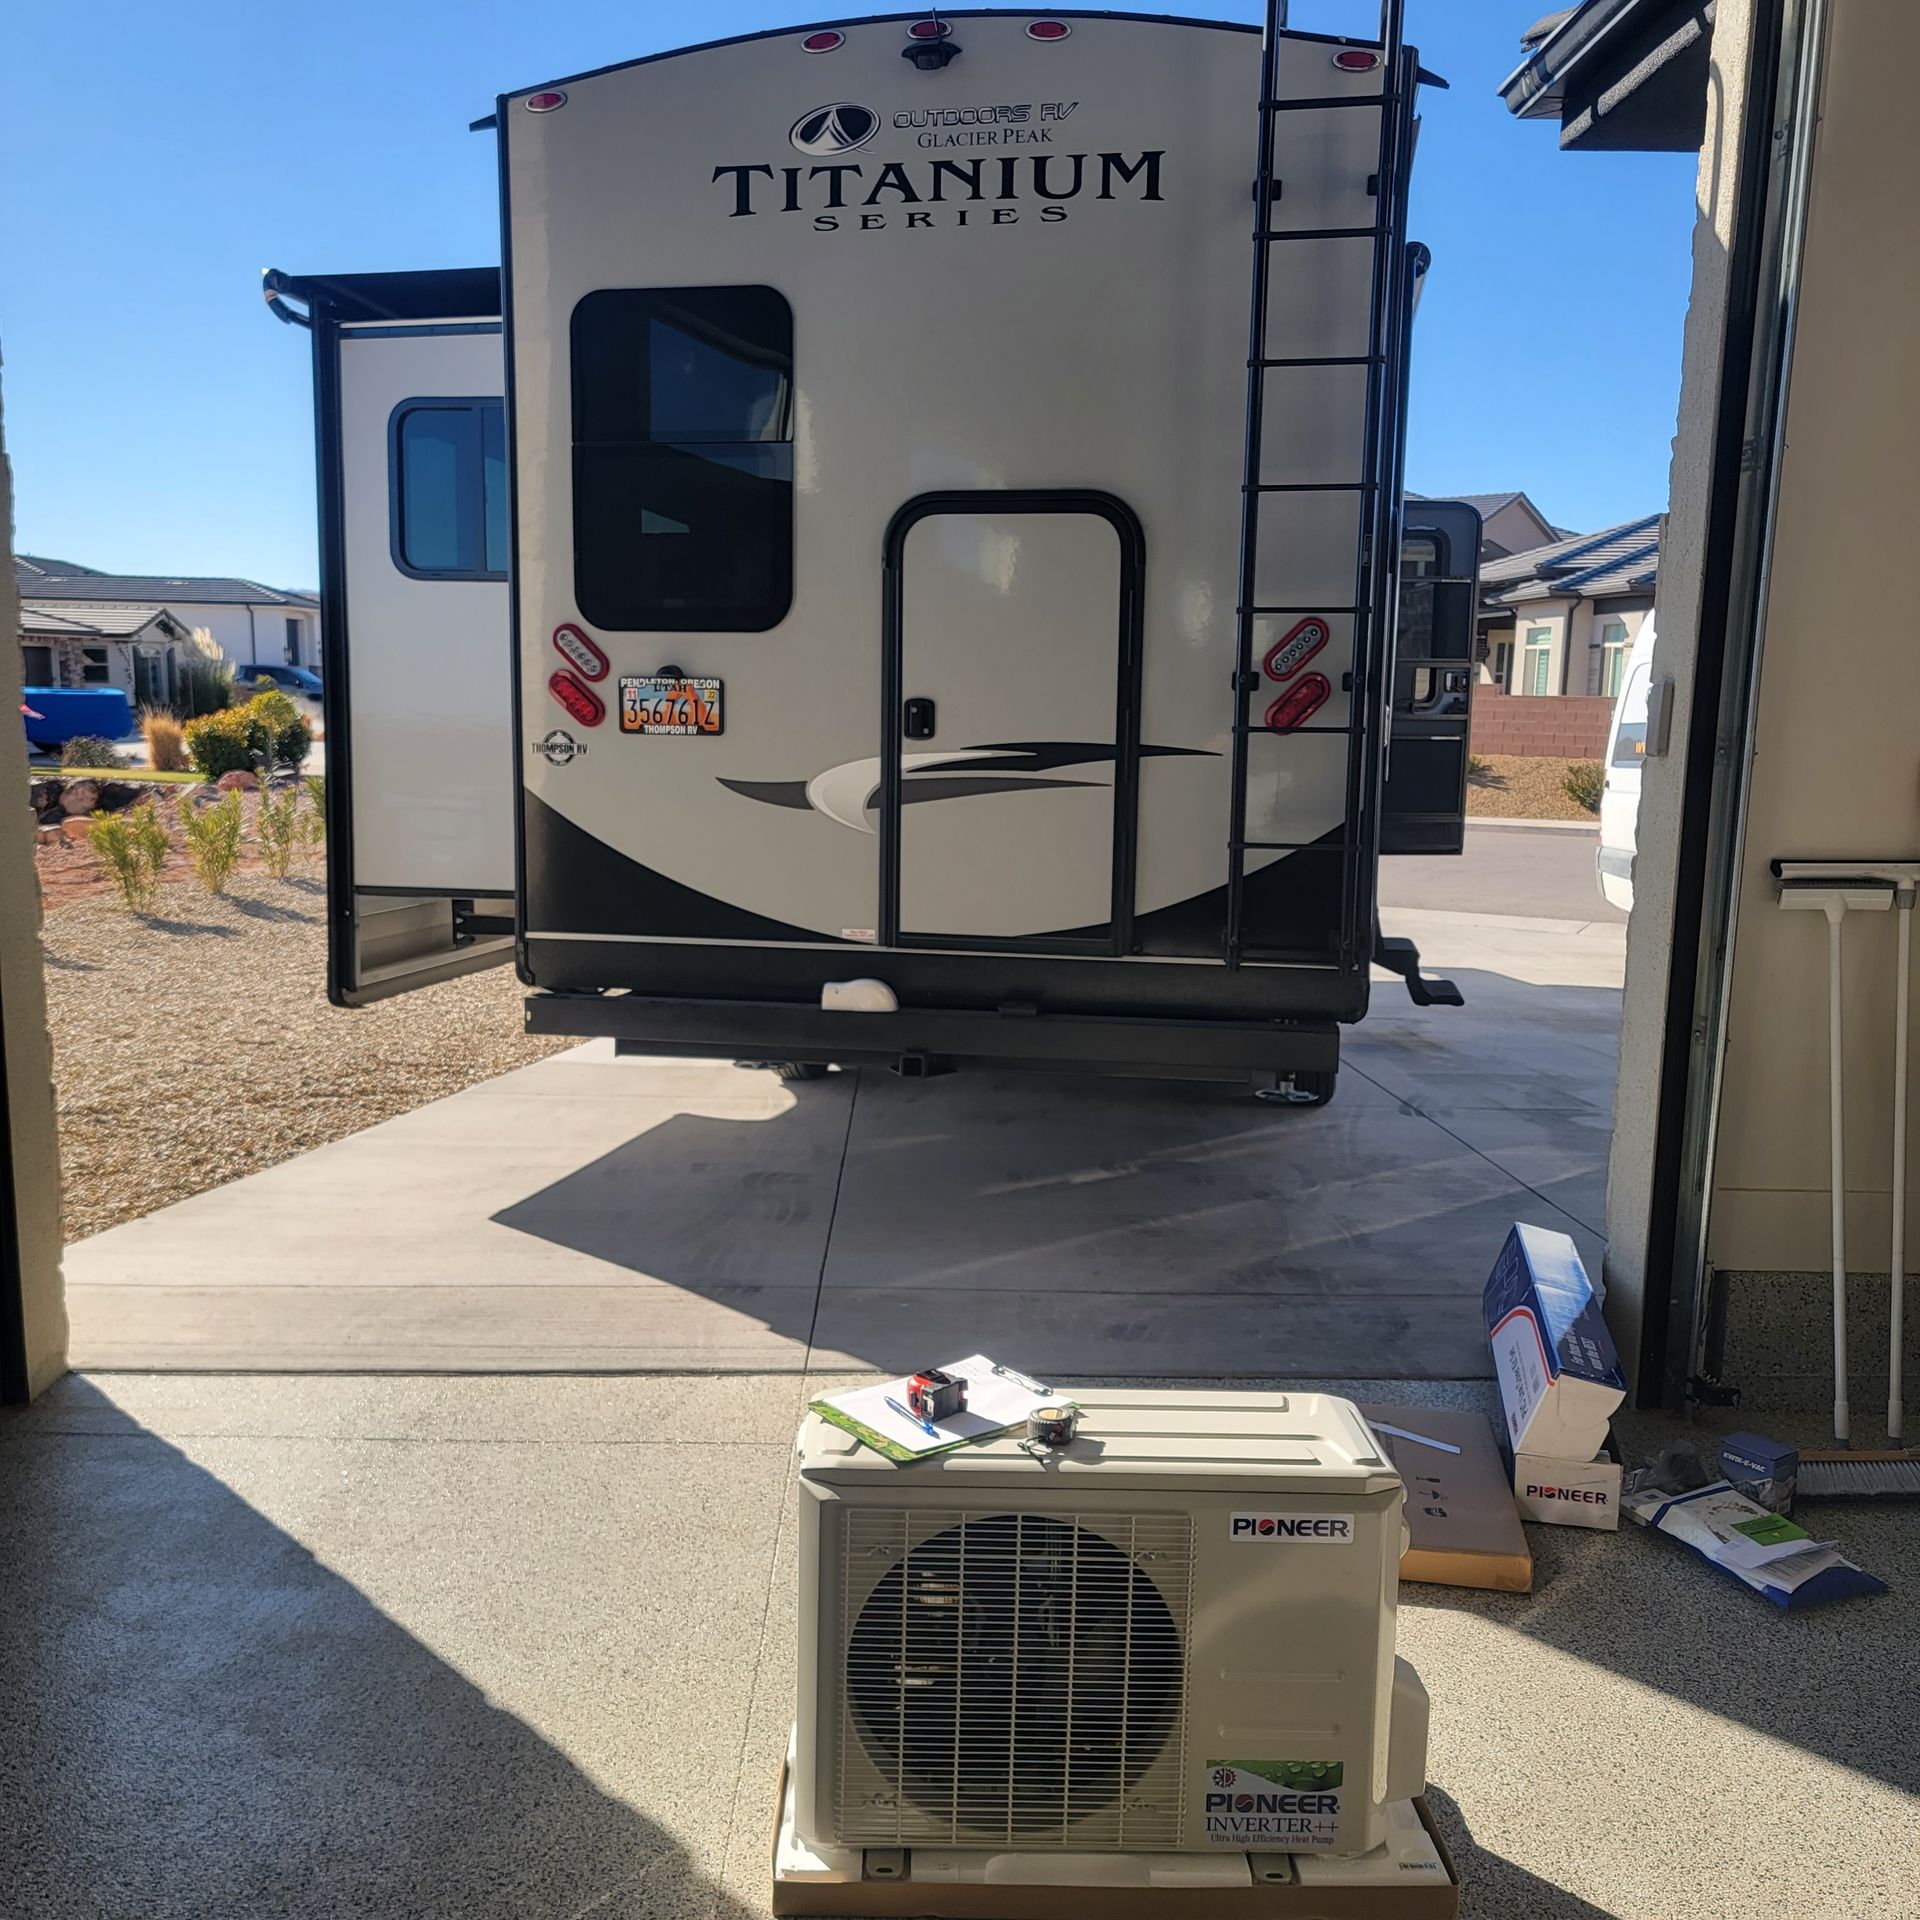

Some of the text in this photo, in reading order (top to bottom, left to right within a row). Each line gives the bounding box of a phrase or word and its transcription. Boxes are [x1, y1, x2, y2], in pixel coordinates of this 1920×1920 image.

[893, 101, 1079, 128] OUTDOORS RV
[917, 127, 1053, 148] GLACIER PEAK
[711, 150, 1168, 218] TITANIUM
[813, 205, 1069, 232] SERIES
[653, 684, 688, 693] UTAH
[680, 678, 720, 690] OREGON
[626, 699, 715, 725] 356761Z
[644, 725, 698, 735] THOMPSON RV
[531, 743, 588, 754] THOMPSON RV
[1722, 1451, 1766, 1473] KWIK-E-VAC
[1526, 1485, 1608, 1504] PIONEER
[1233, 1518, 1350, 1537] PIONEER
[1205, 1793, 1341, 1815] PIONEER
[1211, 1833, 1335, 1845] Ultra High Efficiency Heat Pump
